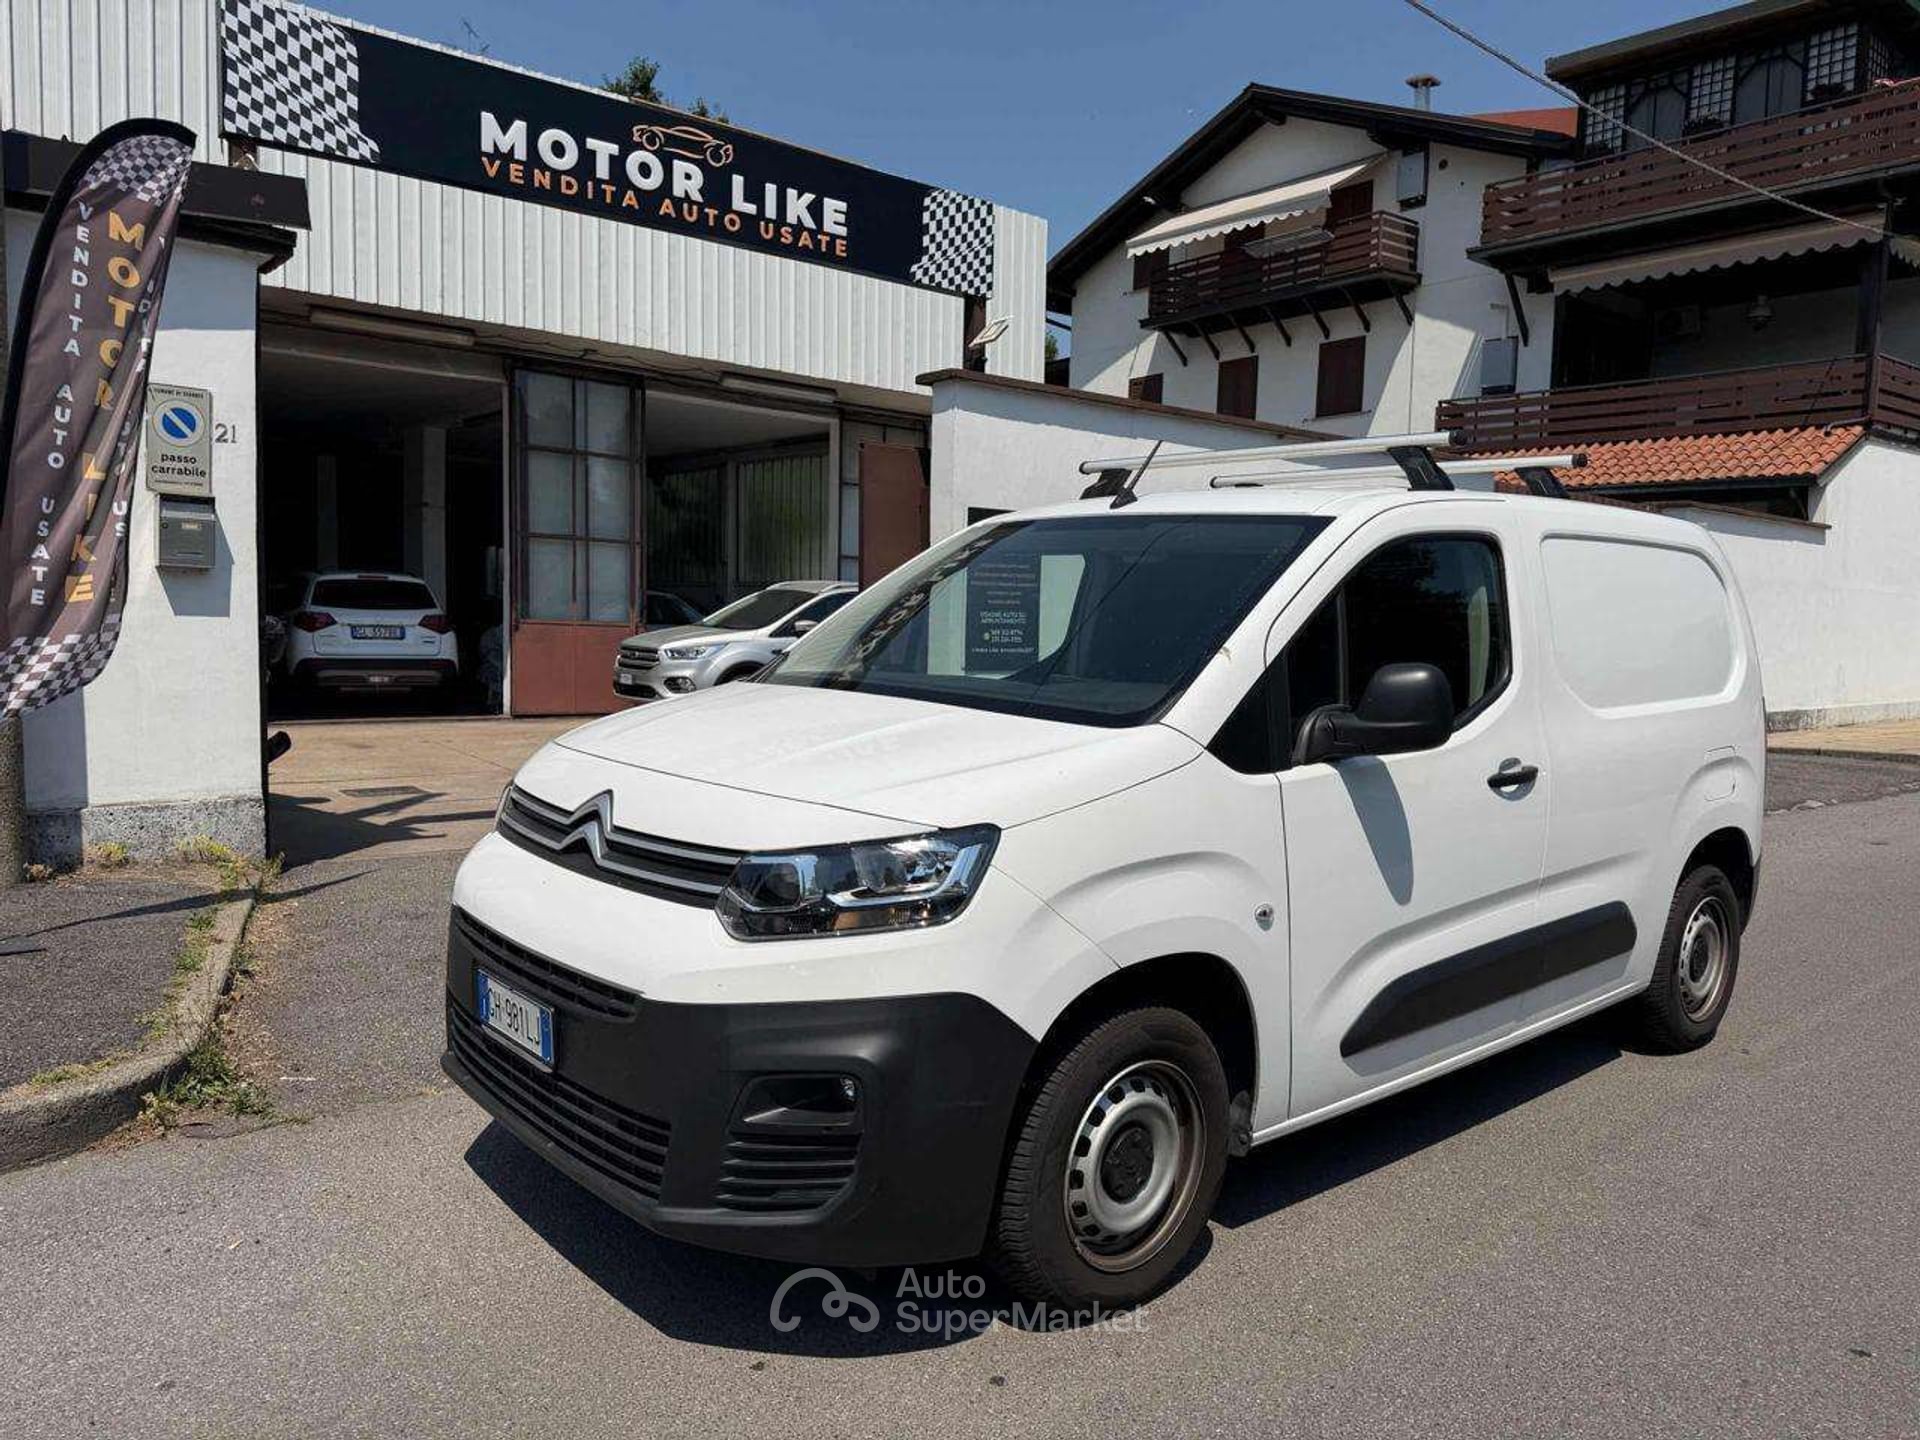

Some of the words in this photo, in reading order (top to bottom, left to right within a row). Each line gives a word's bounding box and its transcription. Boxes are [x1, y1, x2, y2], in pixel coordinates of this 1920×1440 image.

[480, 110, 704, 203] MOTOR
[731, 173, 848, 237] LIKE
[481, 156, 640, 210] VENDITA
[659, 198, 742, 233] AUTO
[759, 221, 848, 258] USATE
[63, 200, 93, 357] VENDITA
[48, 383, 73, 469] AUTO
[151, 465, 207, 479] carrabile
[160, 452, 197, 465] passo
[214, 422, 237, 444] 21
[30, 497, 55, 605] USATE
[64, 452, 107, 602] LIKE
